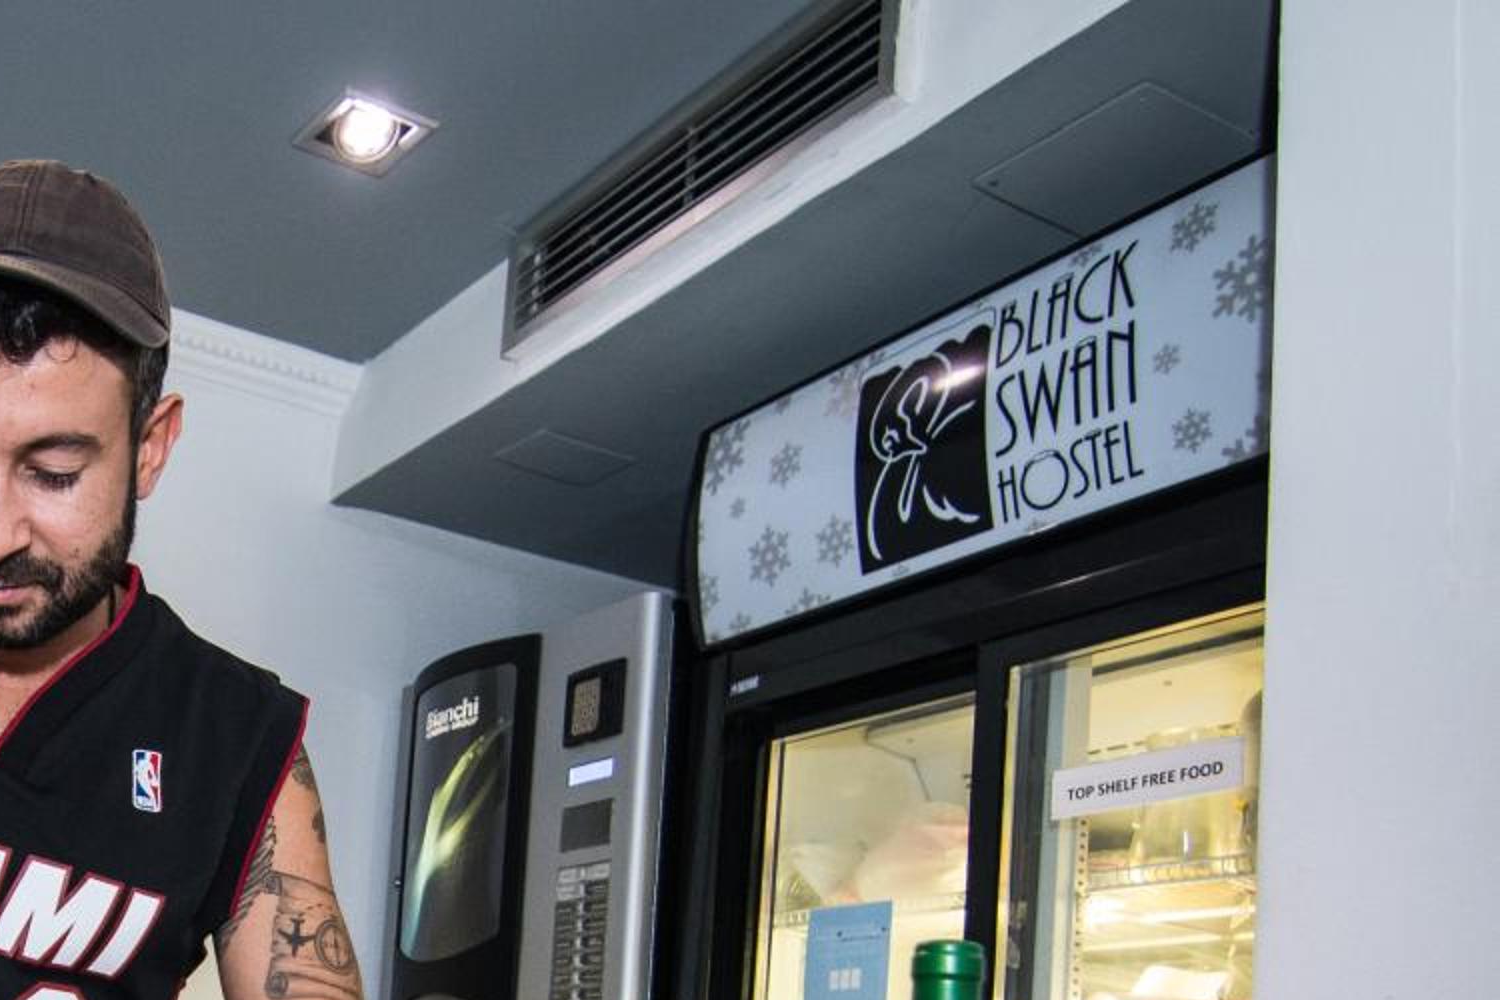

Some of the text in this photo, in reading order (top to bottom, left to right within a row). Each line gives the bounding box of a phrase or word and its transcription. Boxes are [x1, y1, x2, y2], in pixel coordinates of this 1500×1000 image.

[996, 239, 1139, 369] BLACK
[996, 320, 1137, 457] SWAN
[997, 420, 1145, 523] HOSTEL
[1067, 760, 1223, 801] TOP SHELF FREE FOOD
